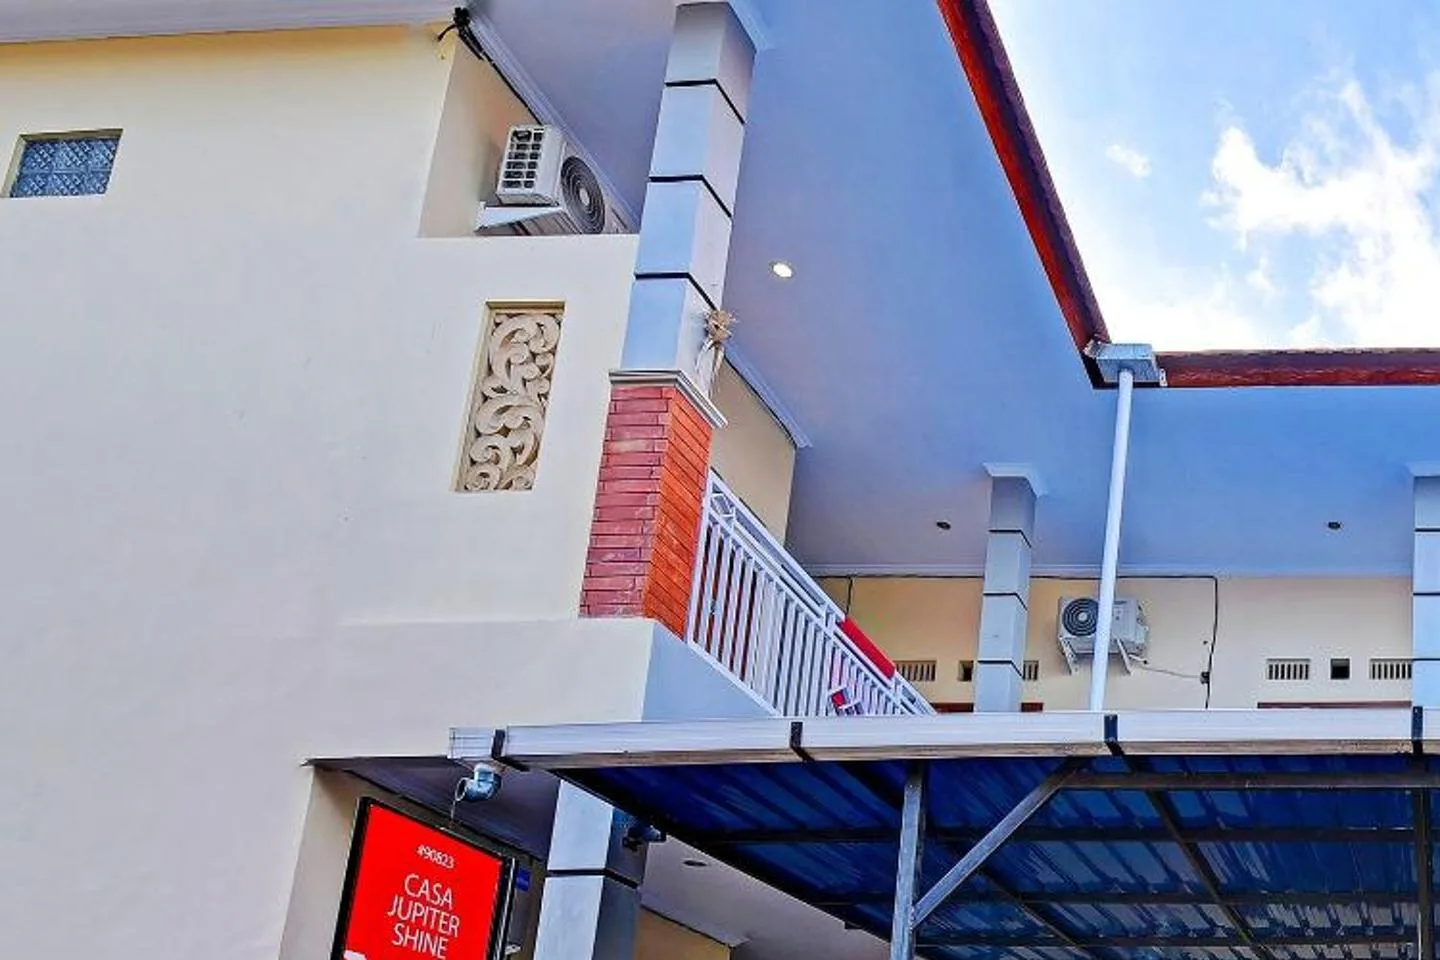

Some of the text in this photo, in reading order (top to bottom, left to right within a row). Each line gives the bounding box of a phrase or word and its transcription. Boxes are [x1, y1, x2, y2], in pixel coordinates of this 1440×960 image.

[405, 874, 452, 910] CASA
[388, 895, 460, 937] JUPITER
[392, 923, 448, 960] SHINE
